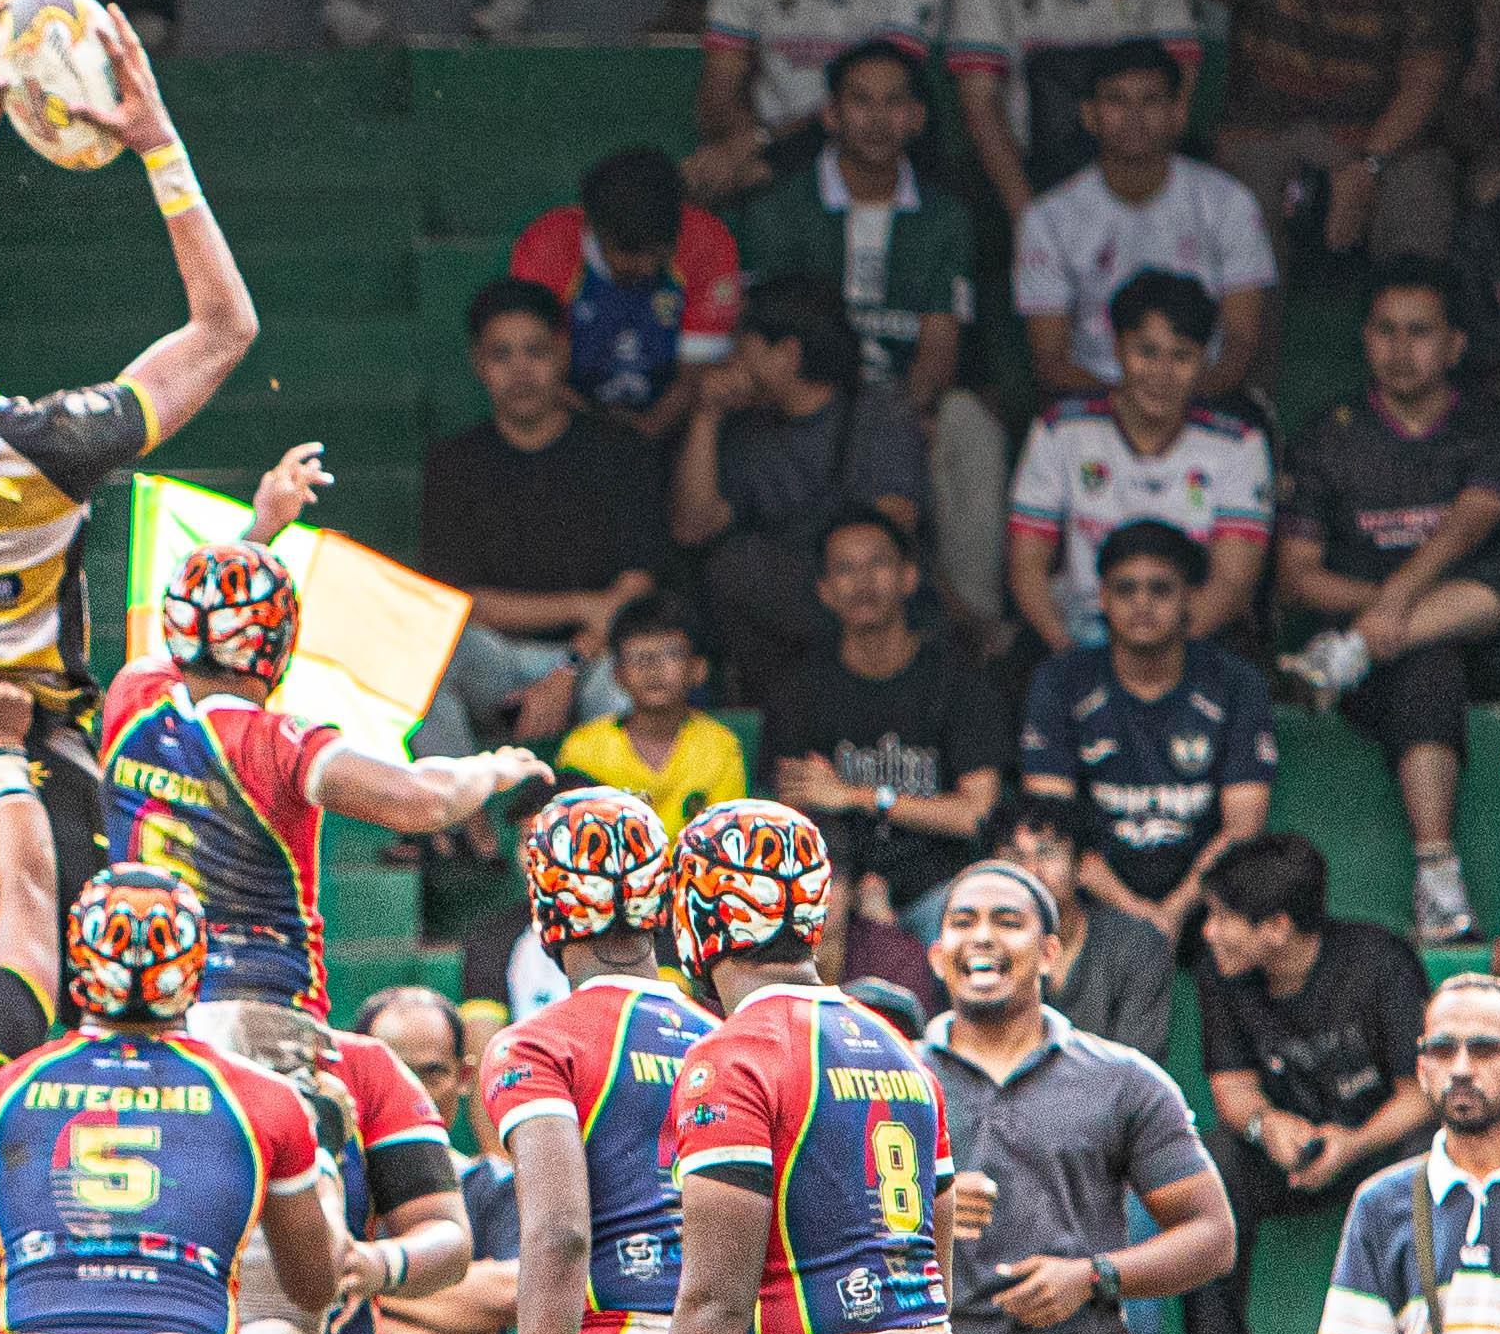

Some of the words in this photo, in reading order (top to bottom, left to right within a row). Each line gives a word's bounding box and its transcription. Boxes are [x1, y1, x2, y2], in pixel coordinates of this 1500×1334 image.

[23, 1080, 213, 1115] INTEGOMB
[826, 1066, 932, 1105] INTEGOM
[70, 1124, 162, 1211] 5
[870, 1120, 924, 1236] 8
